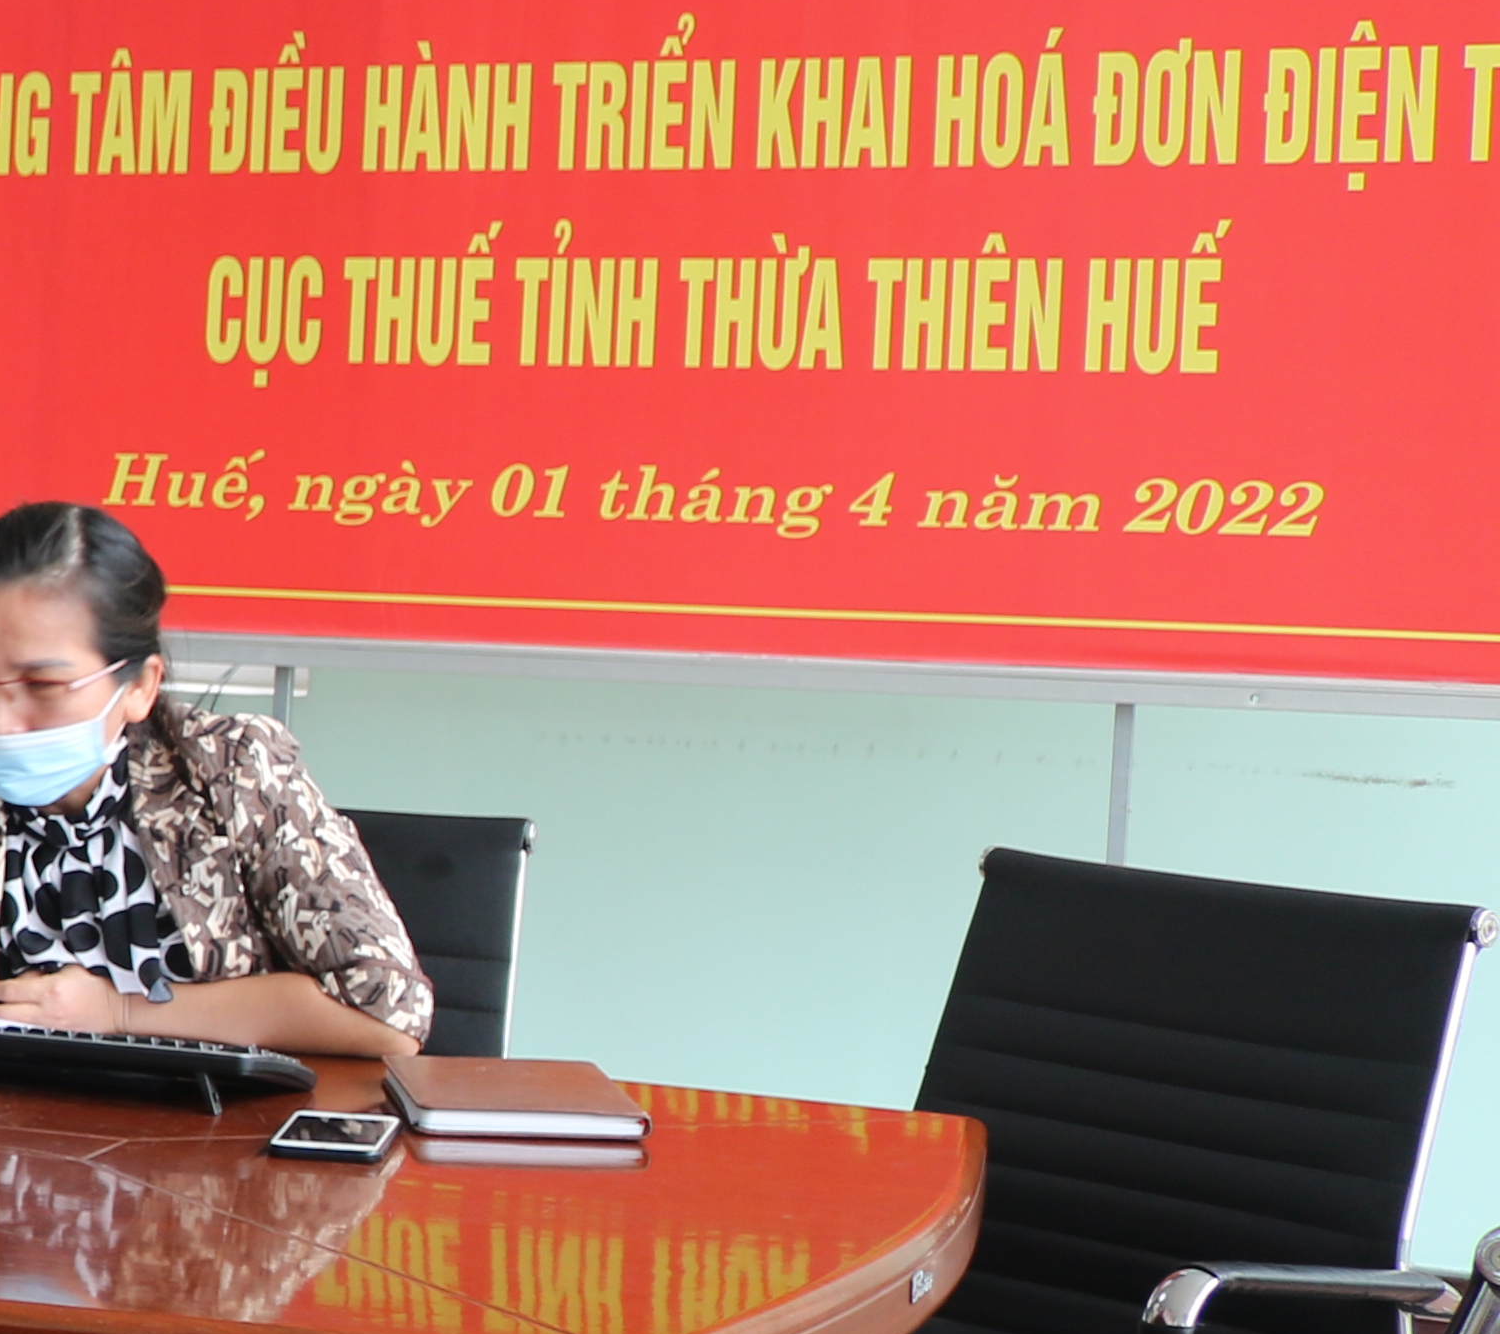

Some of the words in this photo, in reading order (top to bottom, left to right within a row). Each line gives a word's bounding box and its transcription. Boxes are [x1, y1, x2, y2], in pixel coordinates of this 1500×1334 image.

[70, 48, 192, 174] TÂM
[210, 32, 344, 173] ĐIỀU
[363, 41, 532, 171] HÀNH
[553, 13, 736, 170] TRIỂN
[756, 56, 912, 169] KHAI
[934, 27, 1069, 168] HOÁ
[1093, 38, 1242, 167] ĐƠN
[1264, 20, 1439, 191] ĐIỆN
[206, 256, 323, 387] CỤC
[344, 221, 502, 366] THUẾ
[515, 219, 658, 367] TỈNH
[680, 233, 842, 370] THỪA
[867, 233, 1063, 372] THIÊN
[1084, 219, 1232, 374] HUẾ
[103, 450, 265, 520] Huế,
[289, 461, 473, 527] ngày
[491, 464, 568, 517] 01
[600, 465, 833, 538] tháng
[849, 472, 894, 526] 4
[917, 475, 1100, 531] năm
[1123, 478, 1324, 536] 2022
